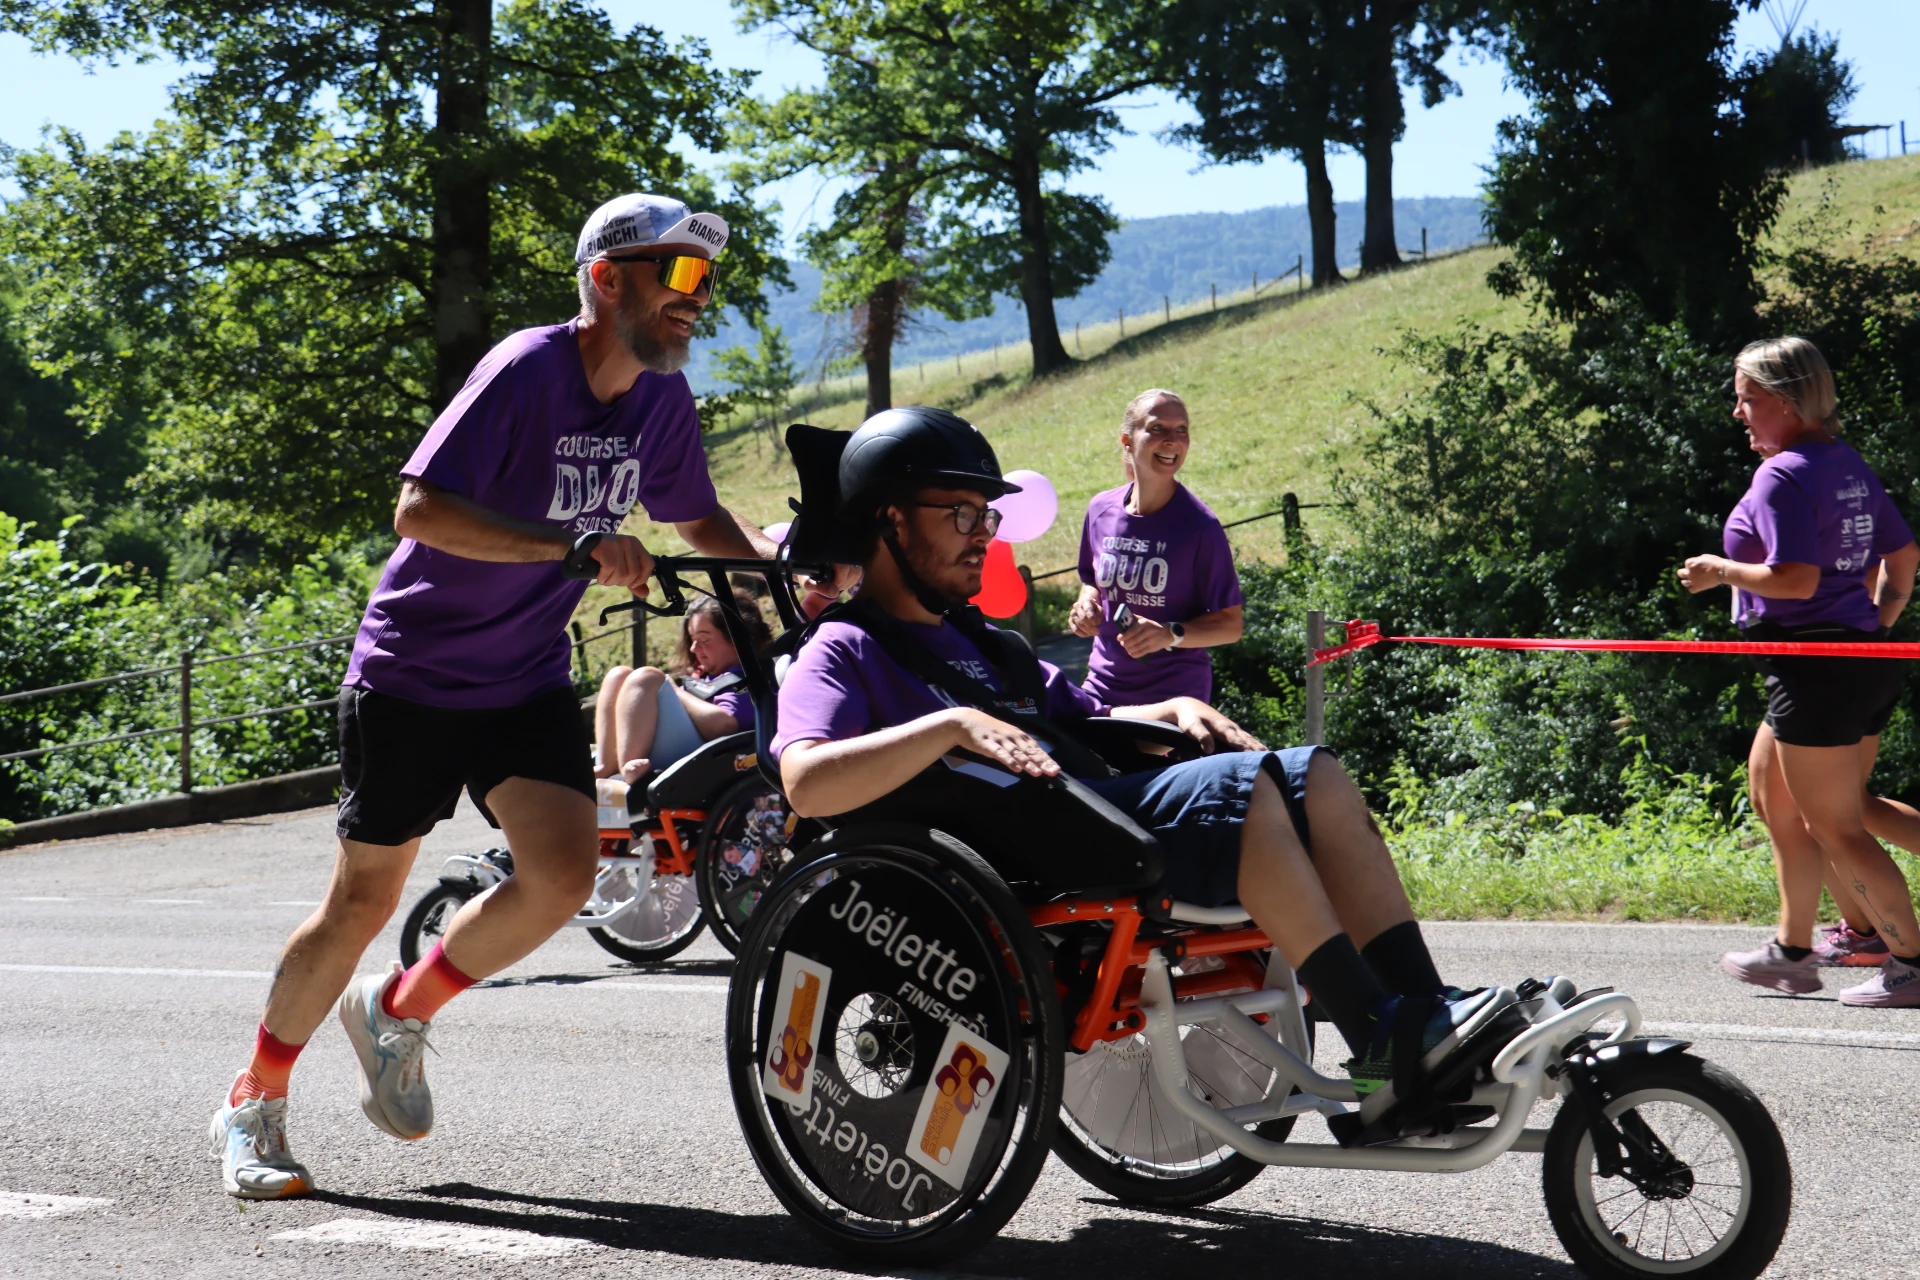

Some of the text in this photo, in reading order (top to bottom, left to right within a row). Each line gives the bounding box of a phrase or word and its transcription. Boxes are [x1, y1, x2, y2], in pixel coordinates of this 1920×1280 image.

[615, 216, 635, 227] COPPI
[688, 219, 727, 248] BIANCHI
[587, 225, 639, 256] BIANCHI
[555, 436, 628, 459] COURSE
[1102, 536, 1150, 553] COURSE
[1098, 552, 1169, 594] DUO
[1125, 592, 1166, 607] SUISSE
[830, 880, 977, 1001] Joëlette
